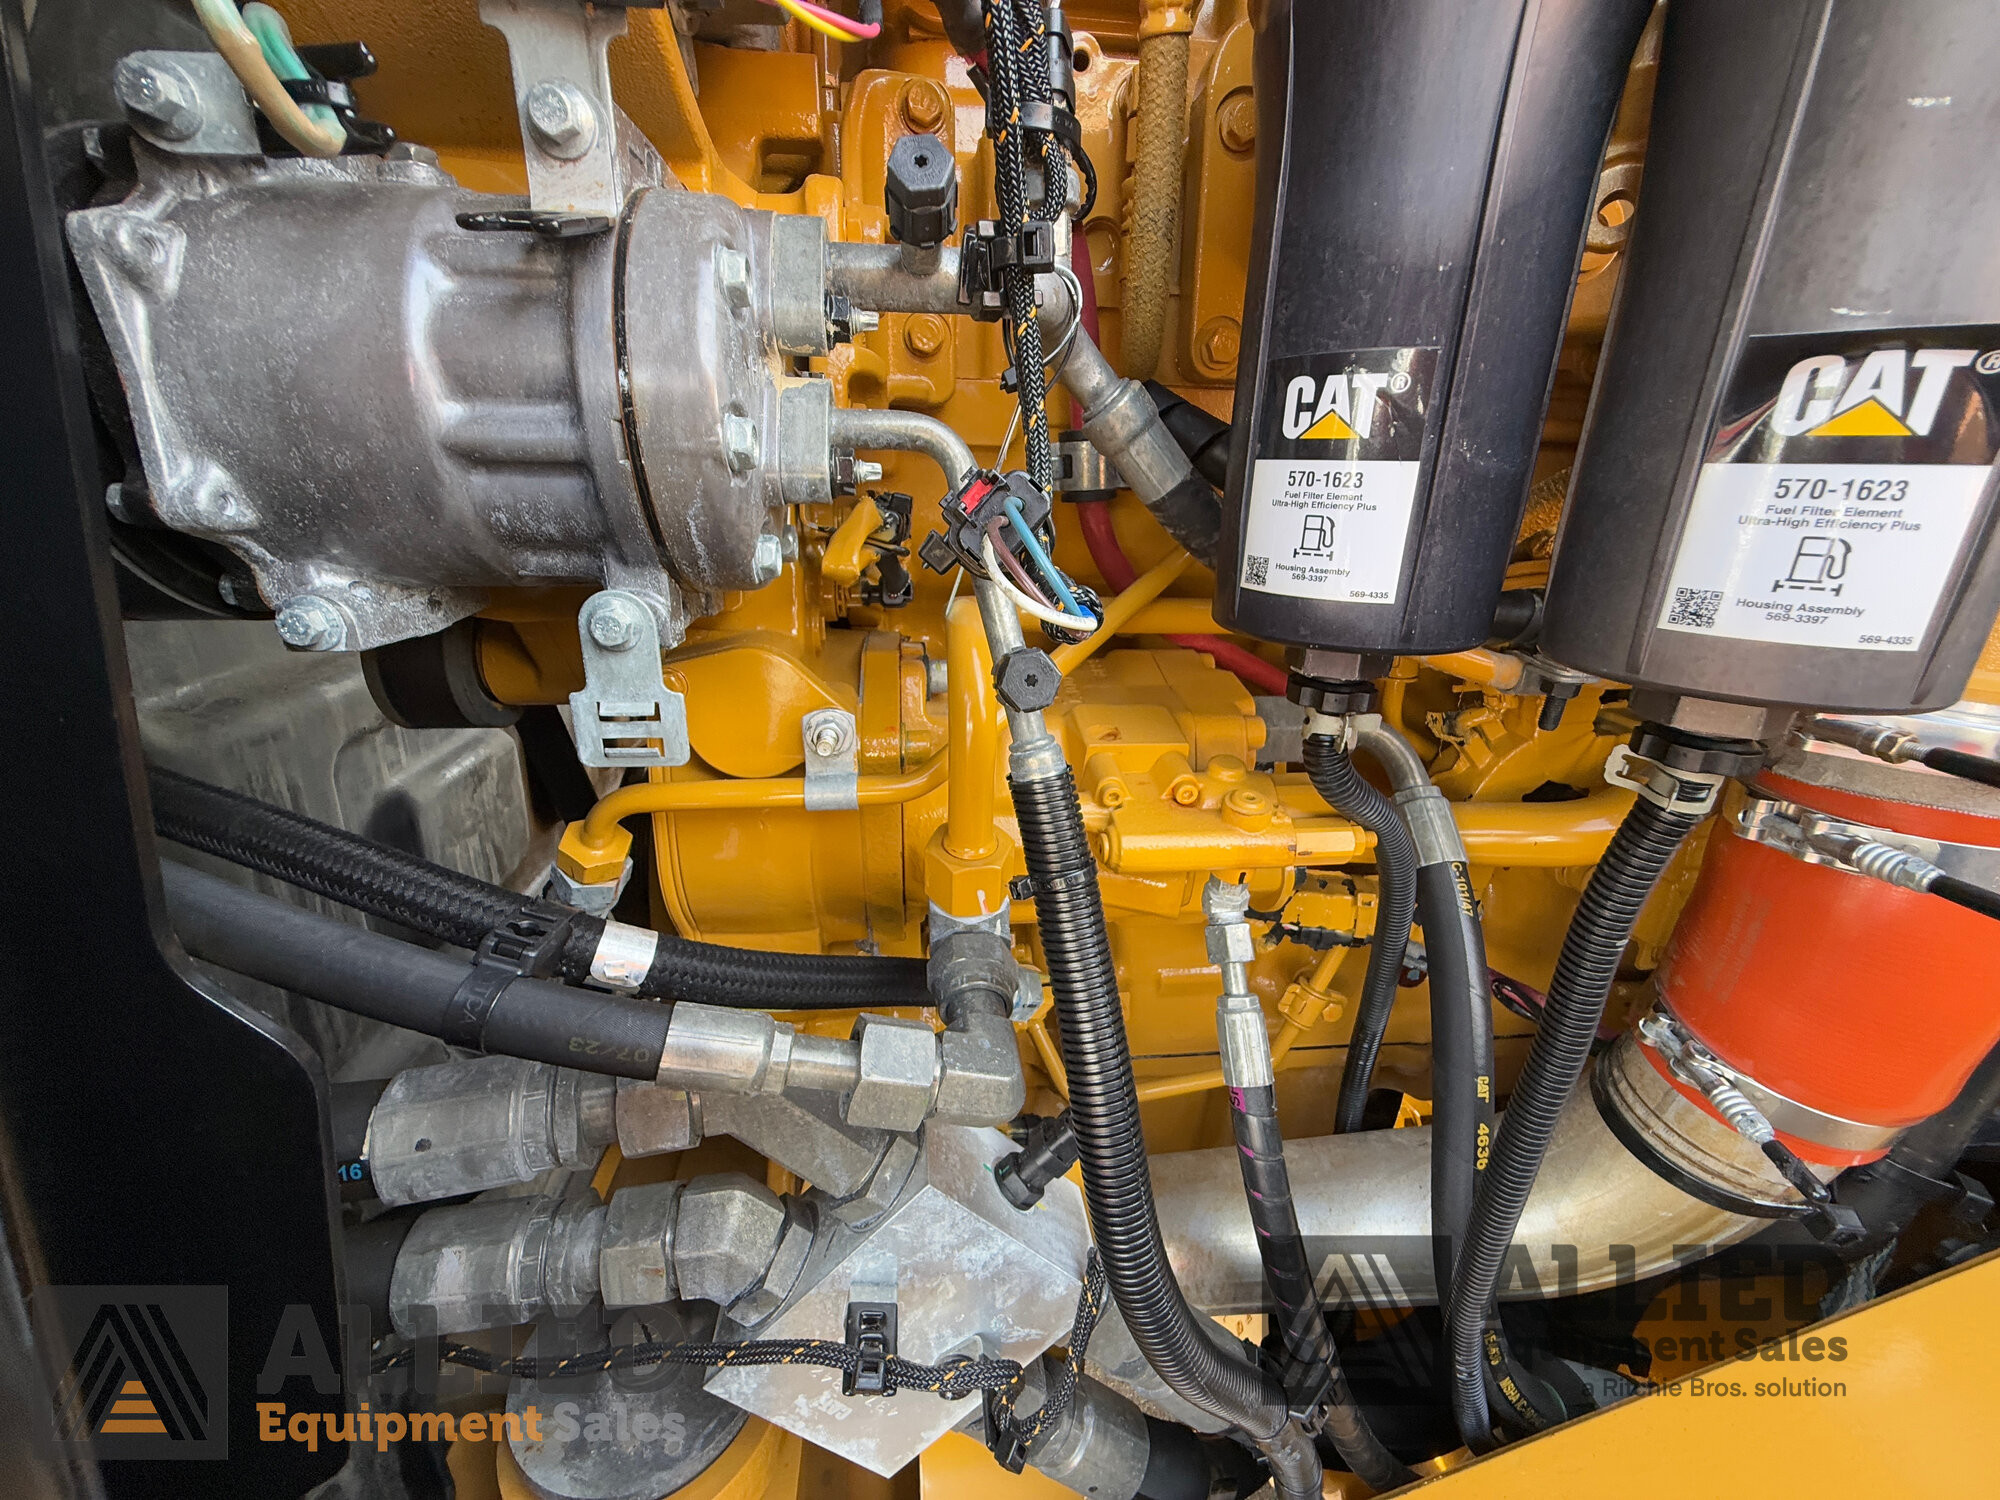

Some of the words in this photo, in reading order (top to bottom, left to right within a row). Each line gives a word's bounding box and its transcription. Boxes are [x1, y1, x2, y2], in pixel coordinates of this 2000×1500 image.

[1287, 470, 1363, 488] 570-1623
[1284, 490, 1301, 499] Fuel
[1303, 491, 1324, 500] Filter
[1326, 492, 1363, 501] Element
[1774, 478, 1910, 501] 570-1623
[1311, 501, 1354, 512] Efficiency
[1356, 502, 1377, 511] Plus
[1765, 504, 1796, 515] Fuel
[1800, 505, 1836, 517] Filter
[1843, 507, 1903, 519] Element
[1890, 520, 1922, 531] Plus
[1275, 563, 1307, 575] Housing
[1308, 566, 1350, 578] Assembly
[1291, 573, 1328, 583] 569-3397
[1349, 590, 1389, 599] 569-4335
[1736, 598, 1793, 612] Housing
[1796, 602, 1866, 617] Assembly
[1765, 612, 1829, 625] 569-3397
[1858, 634, 1914, 645] 569-4335
[1476, 1122, 1490, 1171] 4636
[338, 1163, 362, 1182] 16
